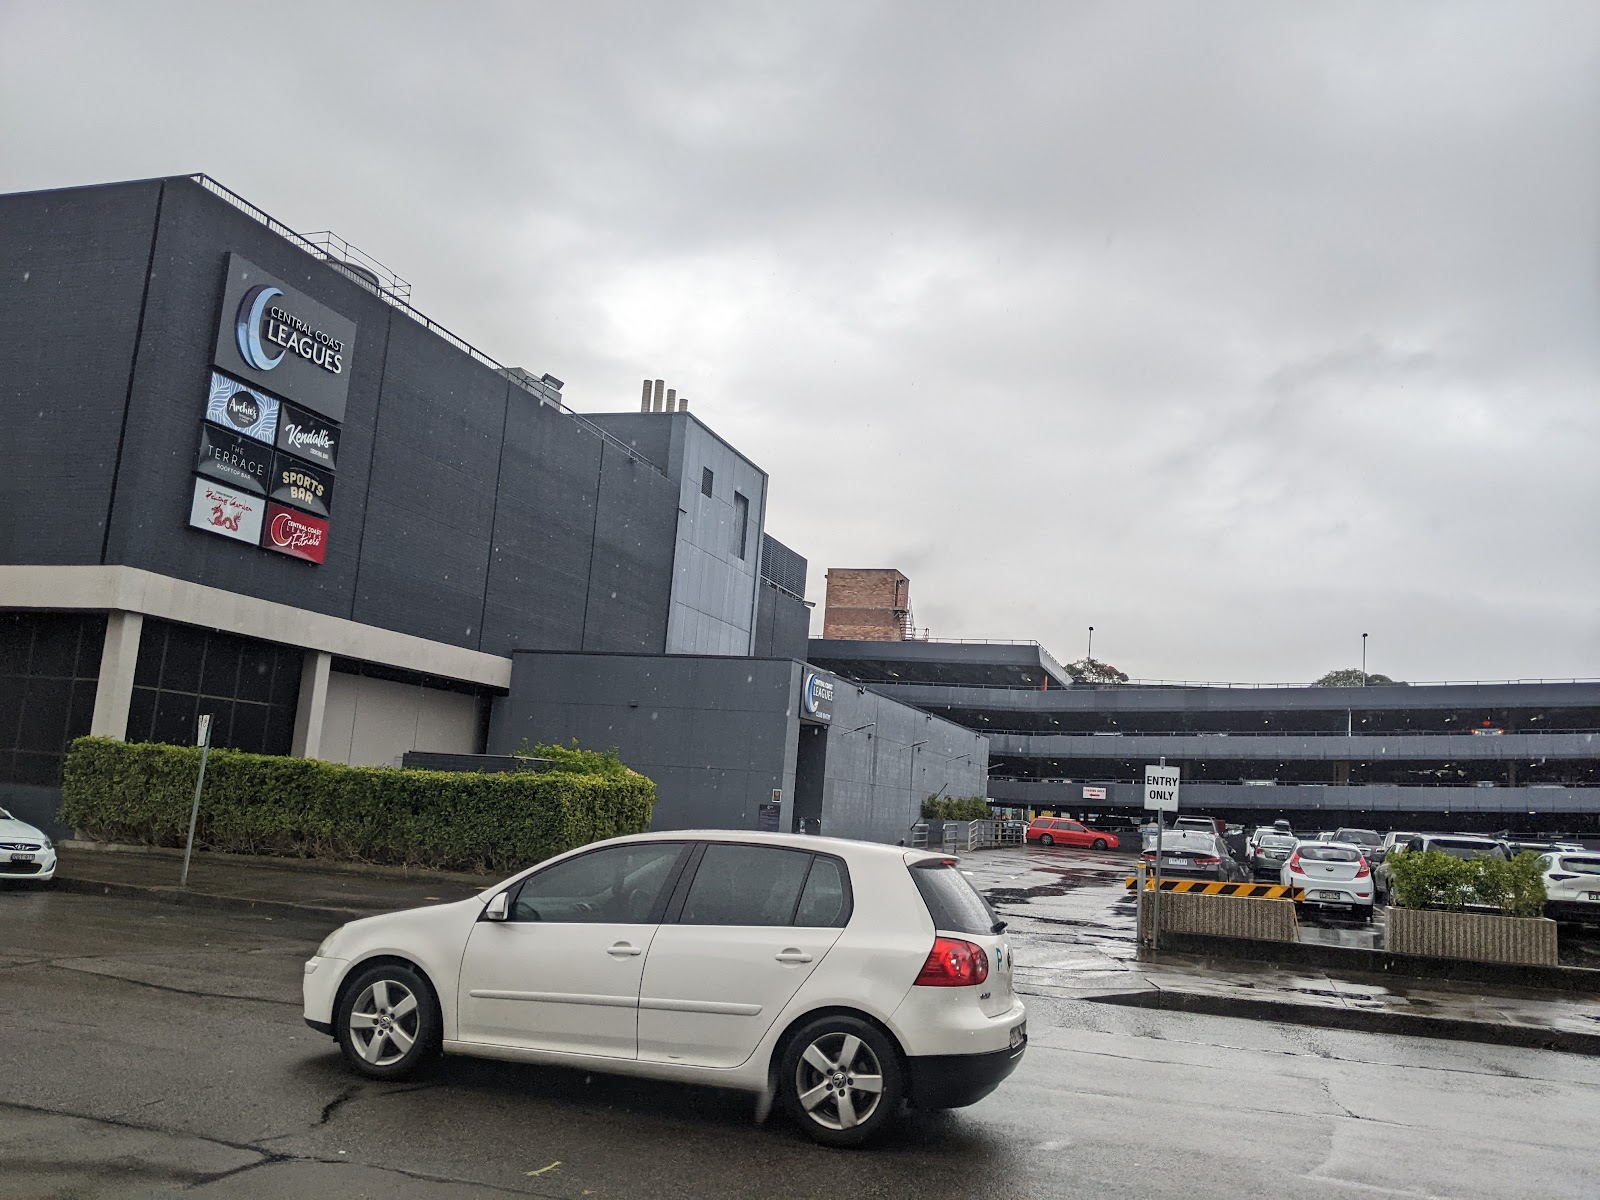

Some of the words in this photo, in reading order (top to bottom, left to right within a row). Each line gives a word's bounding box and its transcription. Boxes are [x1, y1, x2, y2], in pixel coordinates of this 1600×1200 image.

[271, 306, 313, 336] CENTRAL
[315, 330, 345, 352] COAST
[267, 319, 342, 374] LEAGUES
[228, 397, 257, 419] Archie's
[285, 424, 335, 449] Kendall's
[230, 444, 244, 455] THE
[207, 444, 264, 476] TERRACE
[216, 463, 241, 477] ROOFTOP
[241, 472, 251, 480] BAR
[282, 471, 324, 496] SPORTS
[290, 486, 313, 504] BAR
[287, 520, 307, 531] CENTRAL
[307, 527, 322, 536] COAST
[291, 533, 320, 549] Fitness
[813, 685, 834, 701] LEAGUES
[1146, 775, 1178, 788] ENTRY
[1149, 790, 1174, 801] ONLY
